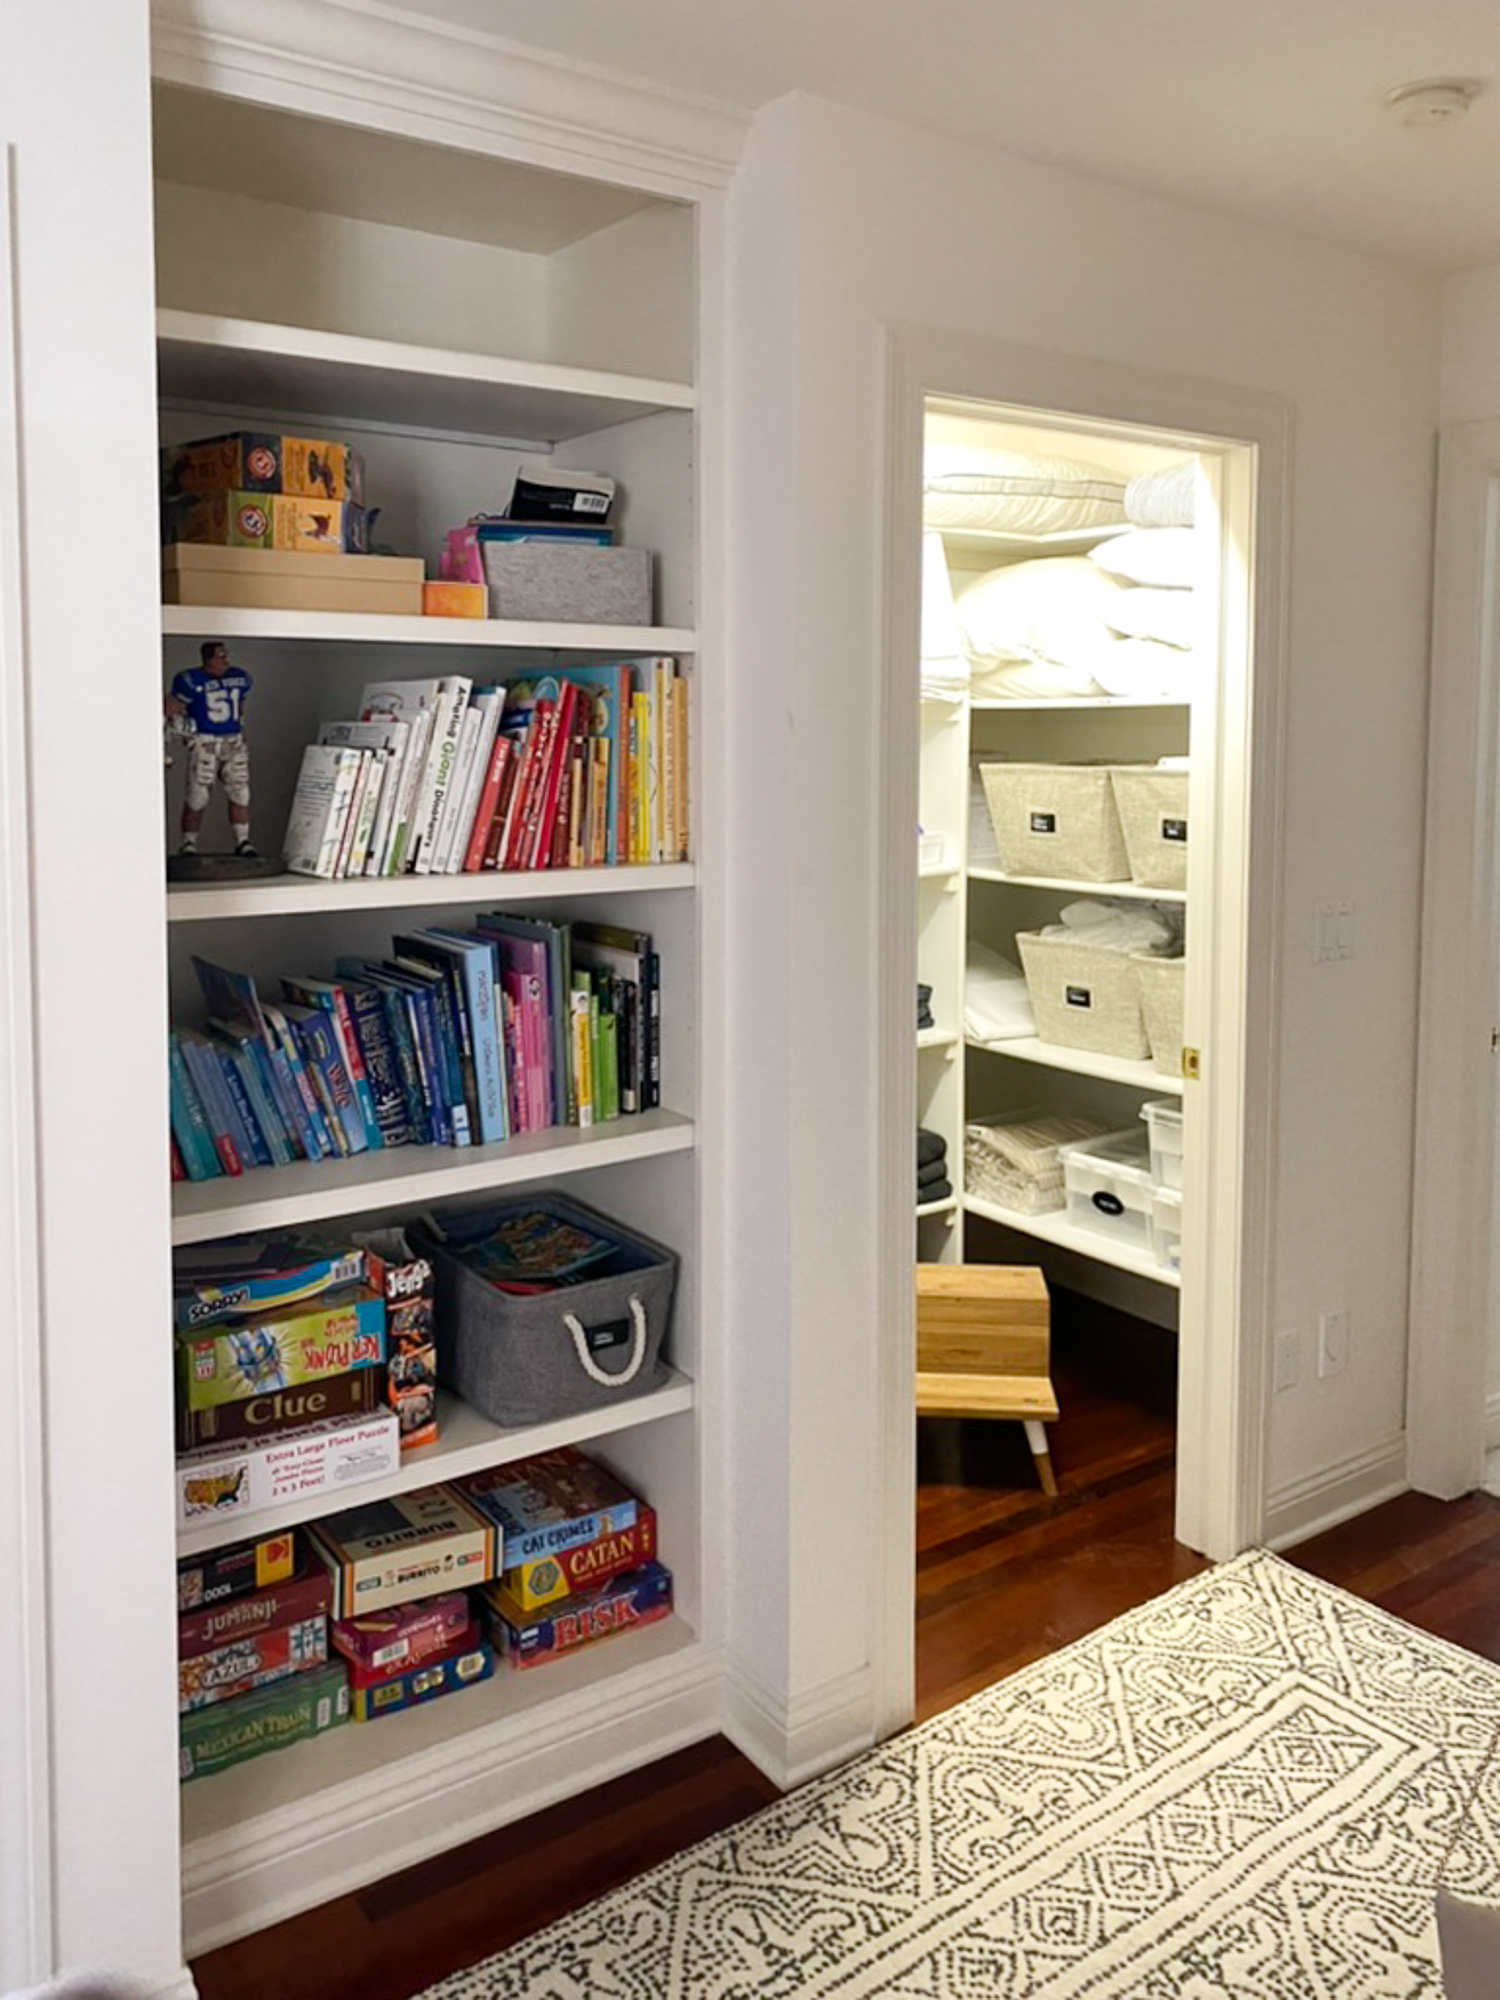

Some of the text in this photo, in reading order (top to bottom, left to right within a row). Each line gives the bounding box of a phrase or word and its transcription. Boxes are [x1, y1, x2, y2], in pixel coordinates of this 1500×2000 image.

[206, 688, 240, 723] 51
[424, 685, 467, 847] Amazing Giant Dinosaurs
[387, 1258, 432, 1298] Jenga
[244, 1392, 327, 1425] Clue
[265, 1425, 389, 1463] Extra Large Floor Puzzle
[299, 1474, 325, 1488] Feet!
[364, 1519, 458, 1549] BURRITO
[522, 1518, 594, 1555] CAT CRIMES
[569, 1533, 635, 1576] CATAN
[397, 1566, 441, 1584] BURRITO
[201, 1599, 277, 1641] JUMANJI
[552, 1590, 640, 1652] RISK
[210, 1657, 252, 1682] AZUL
[196, 1704, 312, 1758] MEXICAN TRAIN
